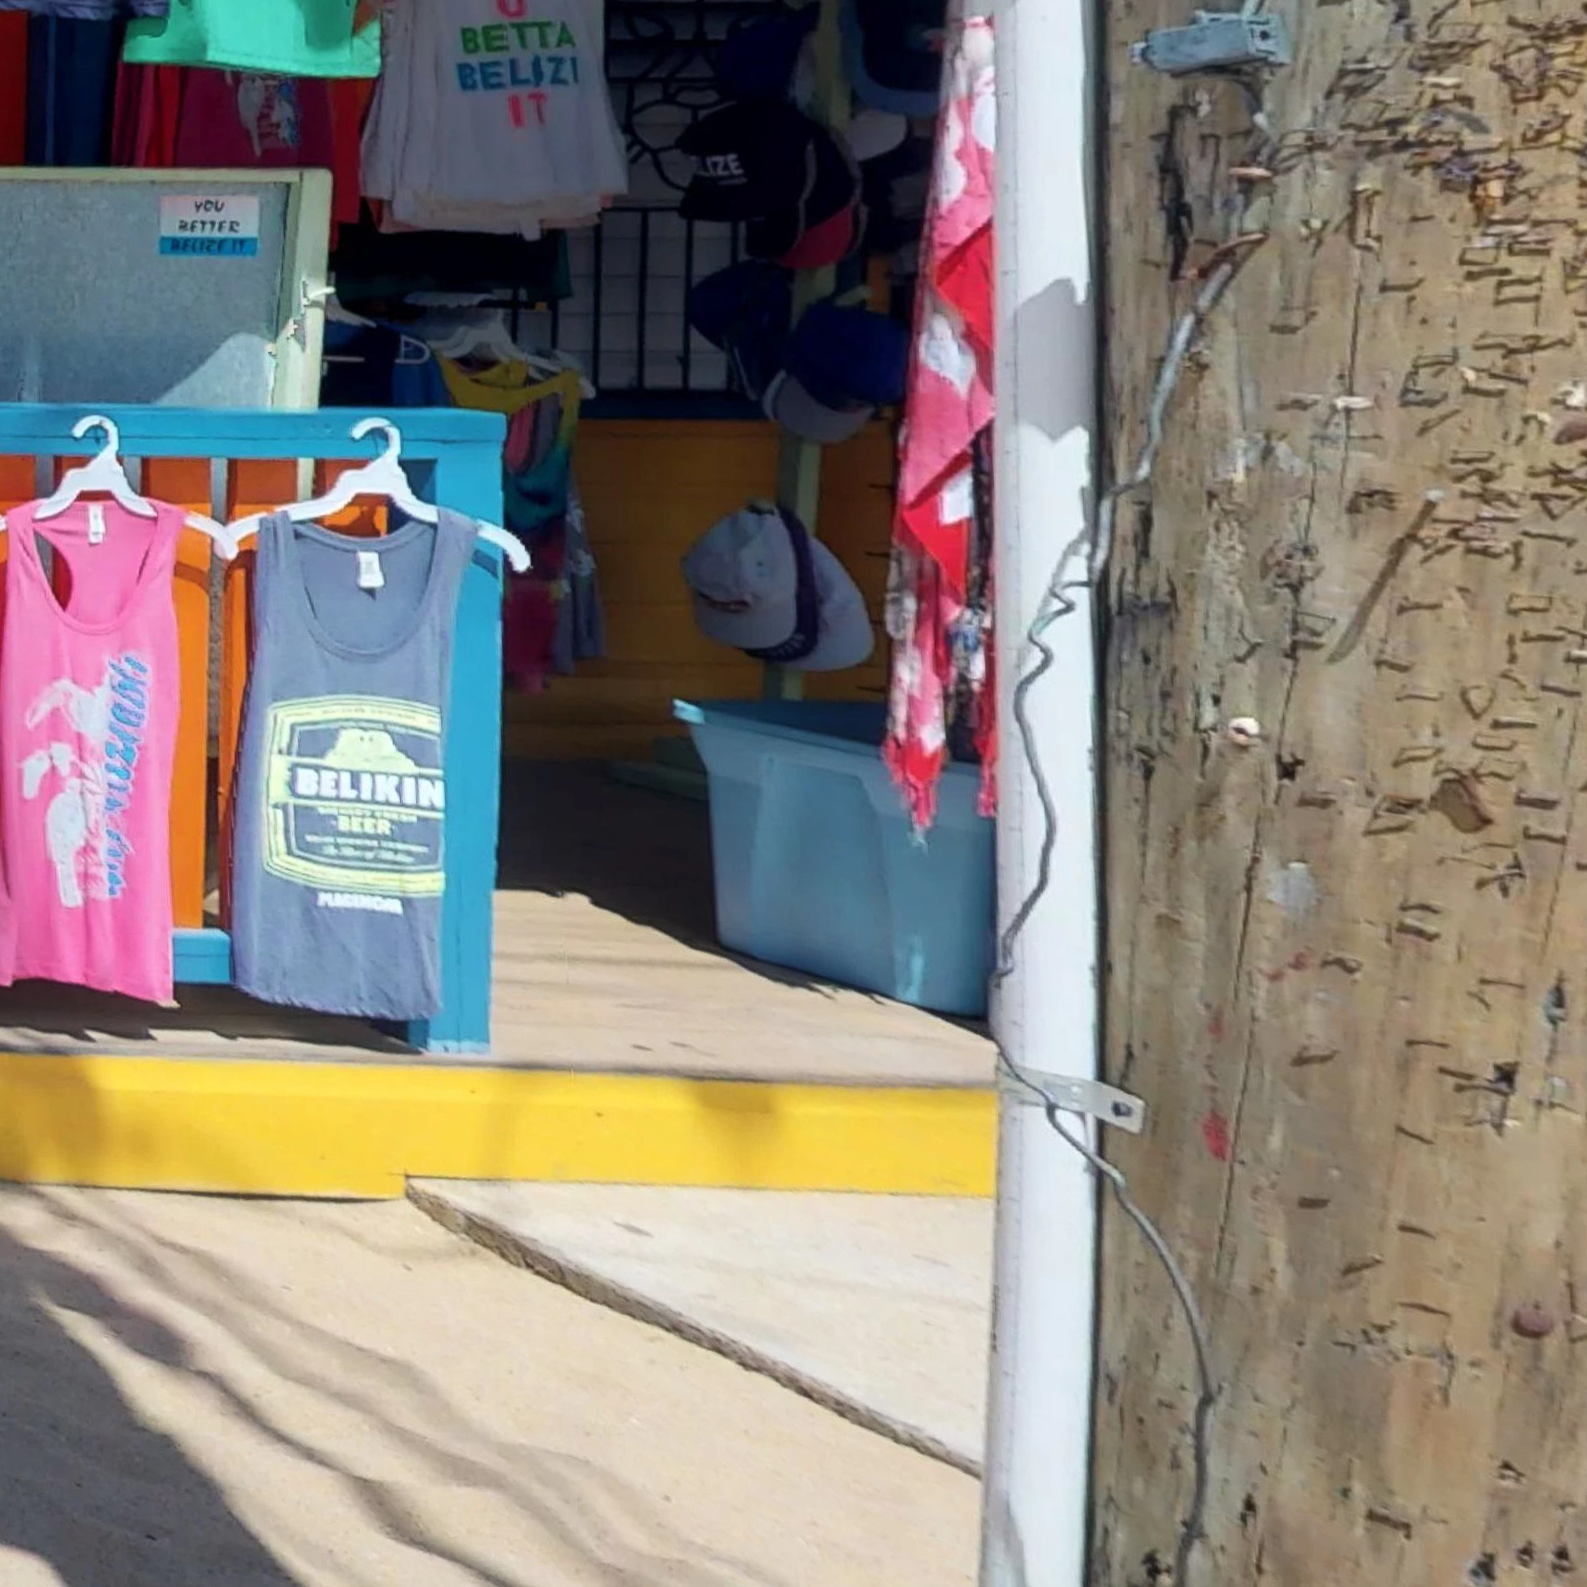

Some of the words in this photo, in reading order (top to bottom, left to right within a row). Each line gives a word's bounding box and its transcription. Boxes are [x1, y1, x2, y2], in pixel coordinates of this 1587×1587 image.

[459, 20, 578, 56] BETTA
[506, 92, 550, 130] IT
[194, 199, 226, 213] YOU
[178, 219, 241, 234] BETTER
[293, 766, 447, 811] BELIKIN
[337, 814, 393, 837] BEER
